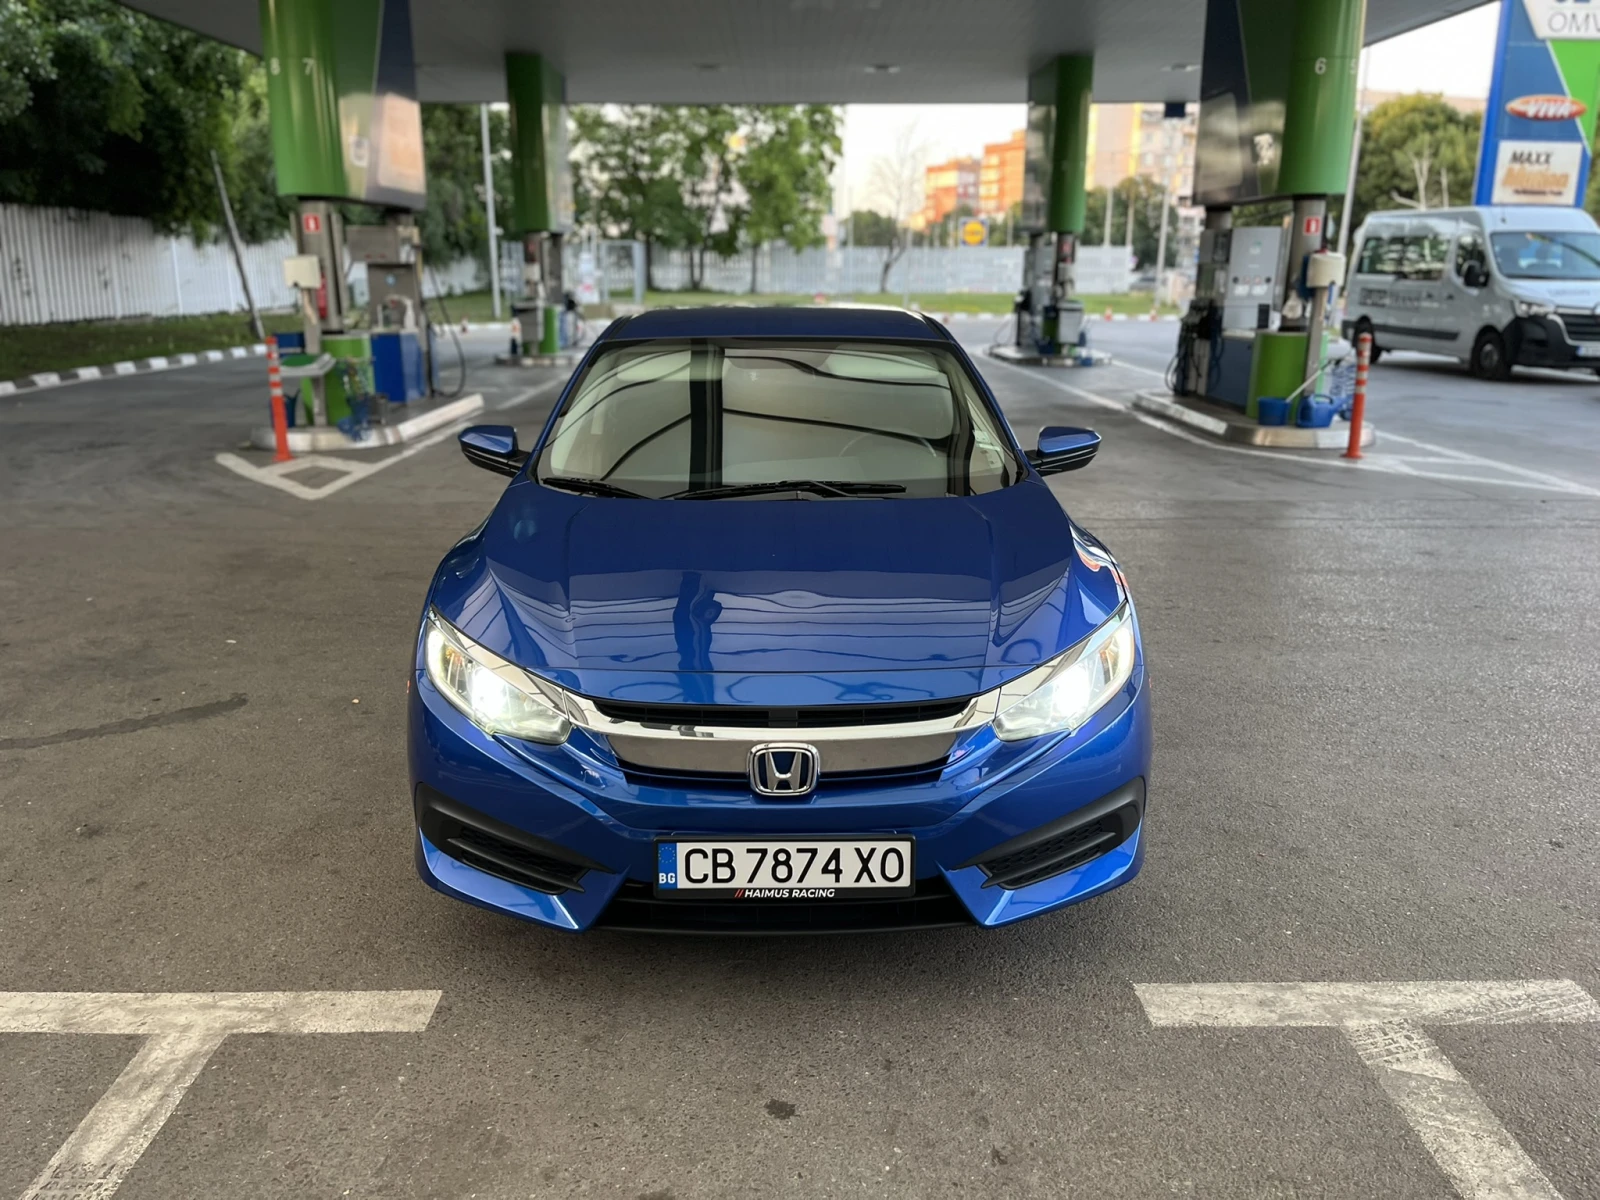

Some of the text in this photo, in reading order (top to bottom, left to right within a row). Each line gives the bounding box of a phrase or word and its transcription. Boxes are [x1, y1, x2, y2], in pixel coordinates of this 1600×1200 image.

[303, 57, 315, 75] 7
[1314, 57, 1327, 75] 6
[685, 847, 905, 884] CB 7874 XO
[658, 873, 676, 884] BG
[792, 888, 835, 898] RACING
